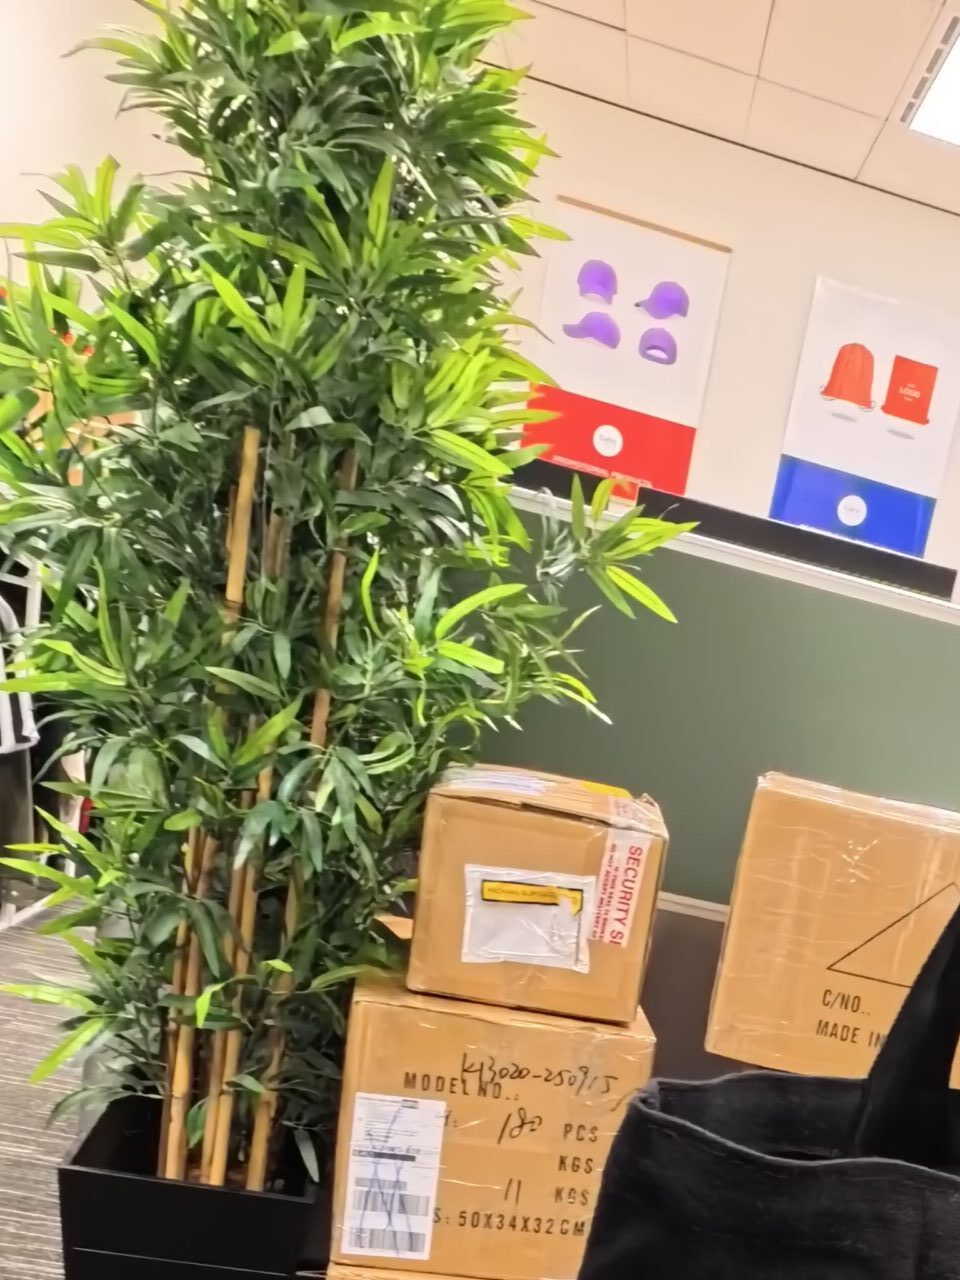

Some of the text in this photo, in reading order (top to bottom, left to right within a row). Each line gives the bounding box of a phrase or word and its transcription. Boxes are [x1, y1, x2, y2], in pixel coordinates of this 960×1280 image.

[614, 845, 643, 927] SECURITY
[816, 1019, 860, 1044] MADE
[403, 1072, 469, 1095] MODEL
[497, 1107, 542, 1144] 180
[563, 1123, 599, 1143] PCS
[558, 1155, 594, 1174] KGS
[555, 1187, 590, 1206] KGS
